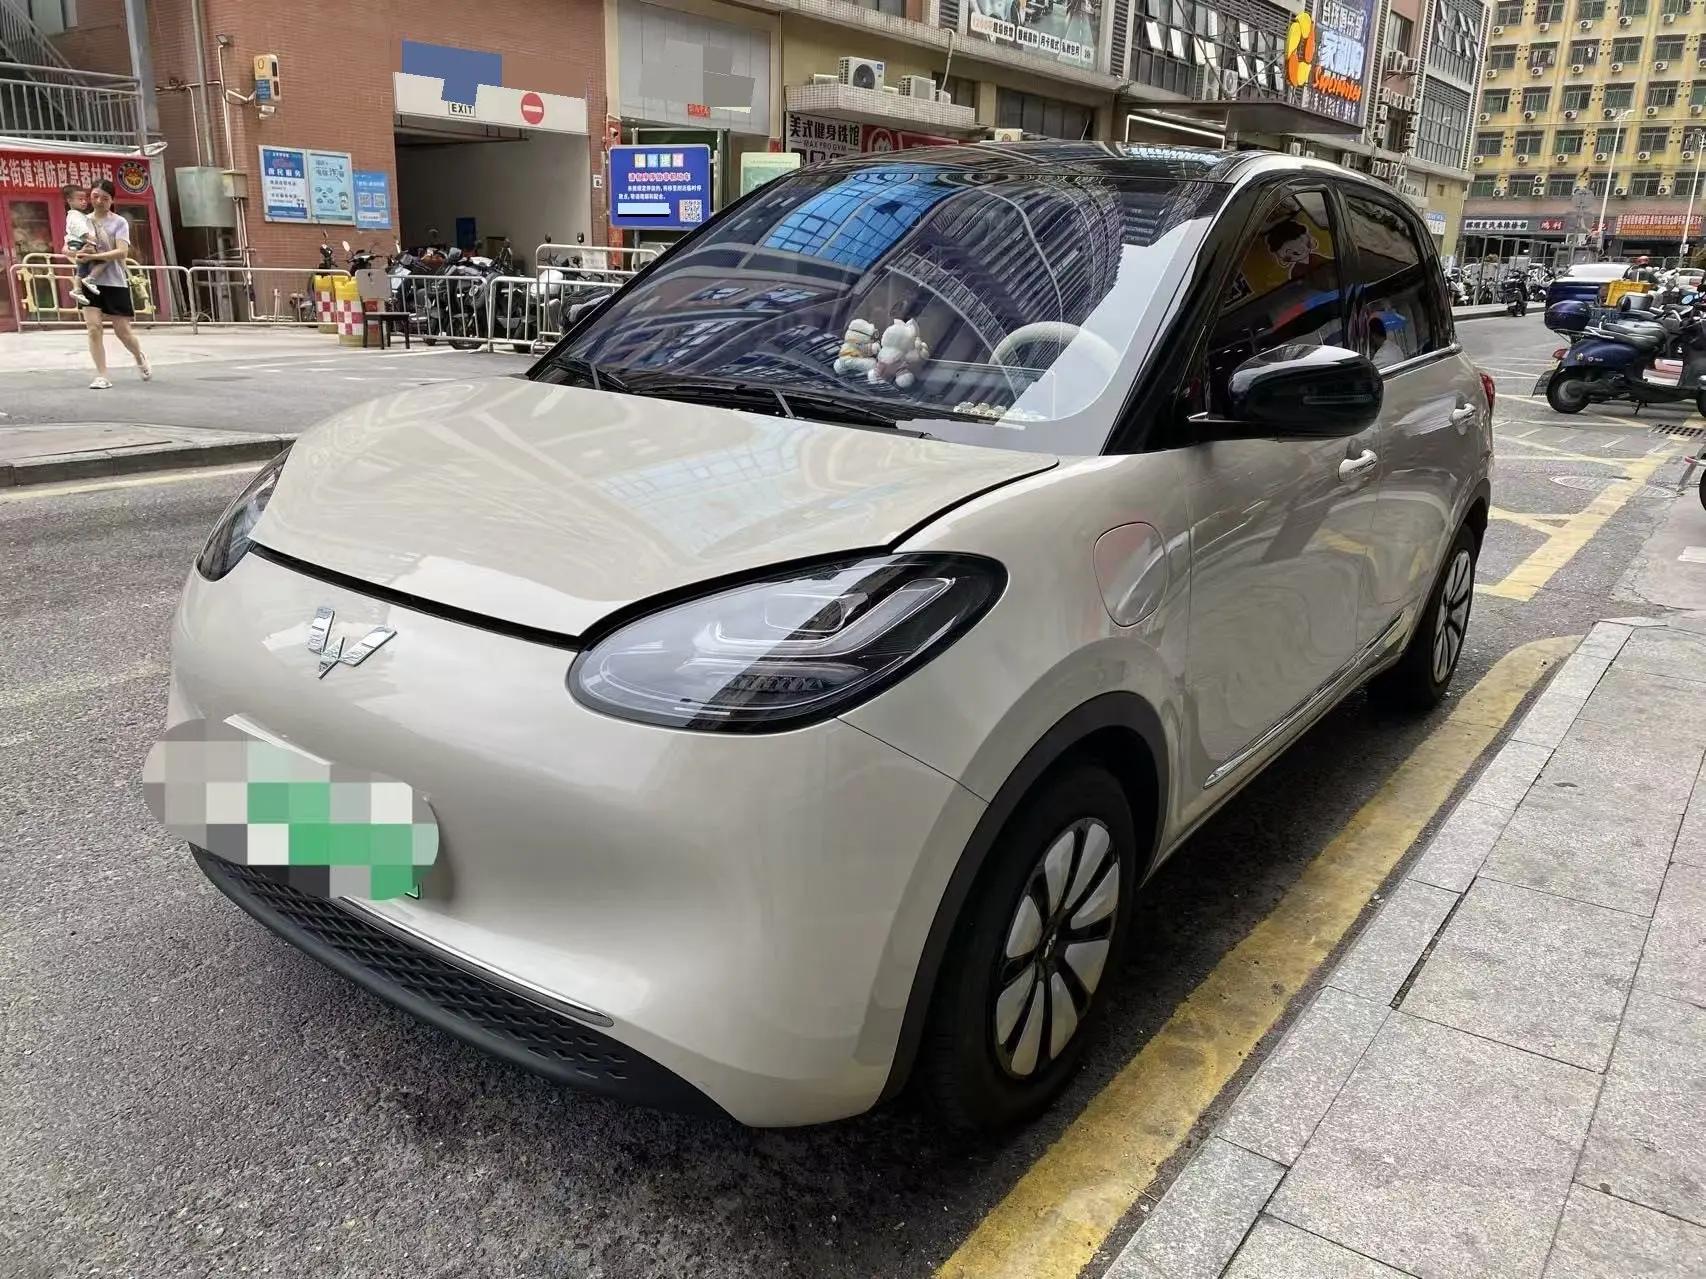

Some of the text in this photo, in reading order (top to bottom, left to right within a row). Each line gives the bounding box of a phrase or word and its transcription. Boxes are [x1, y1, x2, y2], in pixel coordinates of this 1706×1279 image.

[452, 104, 472, 114] EXIT
[789, 115, 859, 147] 美式健身铁馆
